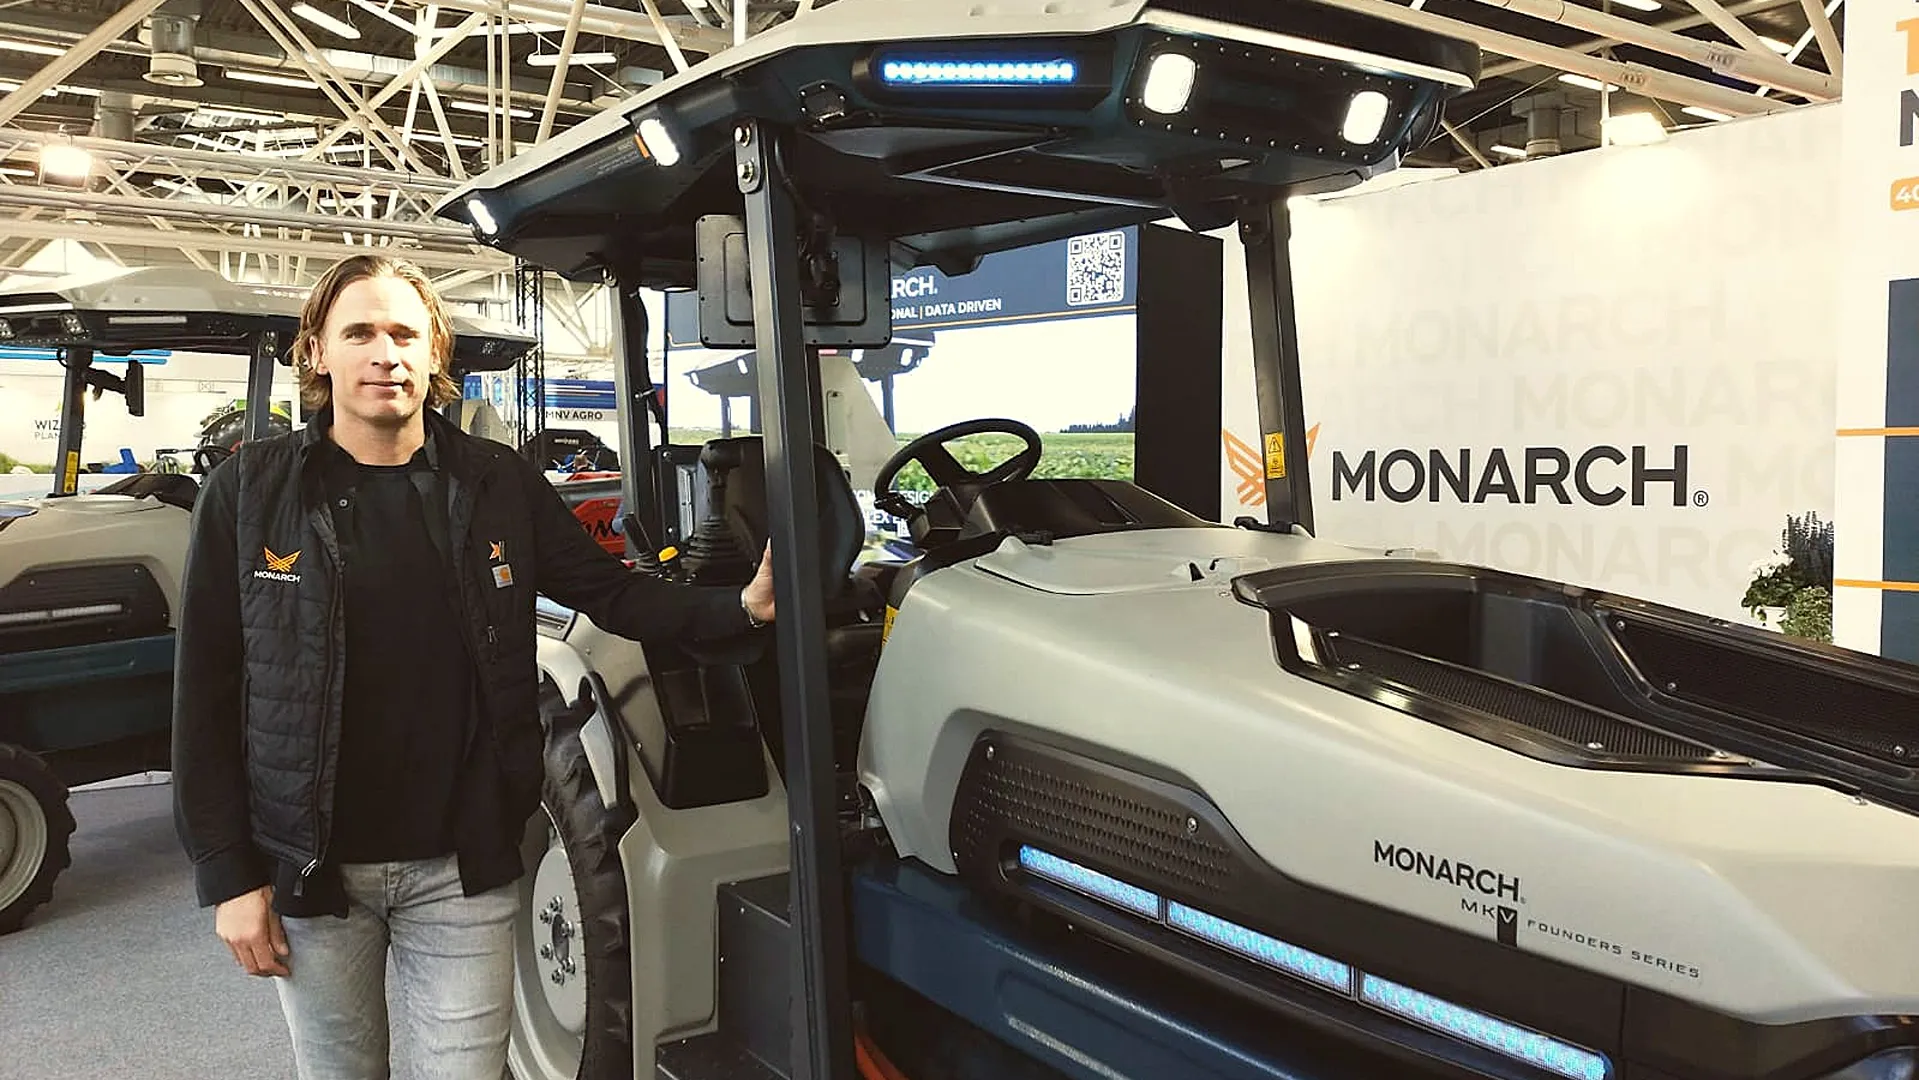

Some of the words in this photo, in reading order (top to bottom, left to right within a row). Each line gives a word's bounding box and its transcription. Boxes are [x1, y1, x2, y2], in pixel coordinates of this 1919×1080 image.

[924, 303, 956, 316] DATA
[957, 298, 1002, 314] DRIVEN
[572, 411, 603, 420] AGRO
[253, 570, 301, 582] MONARCH
[1527, 919, 1622, 956] FOUNDERS
[1631, 950, 1700, 979] SERIES
